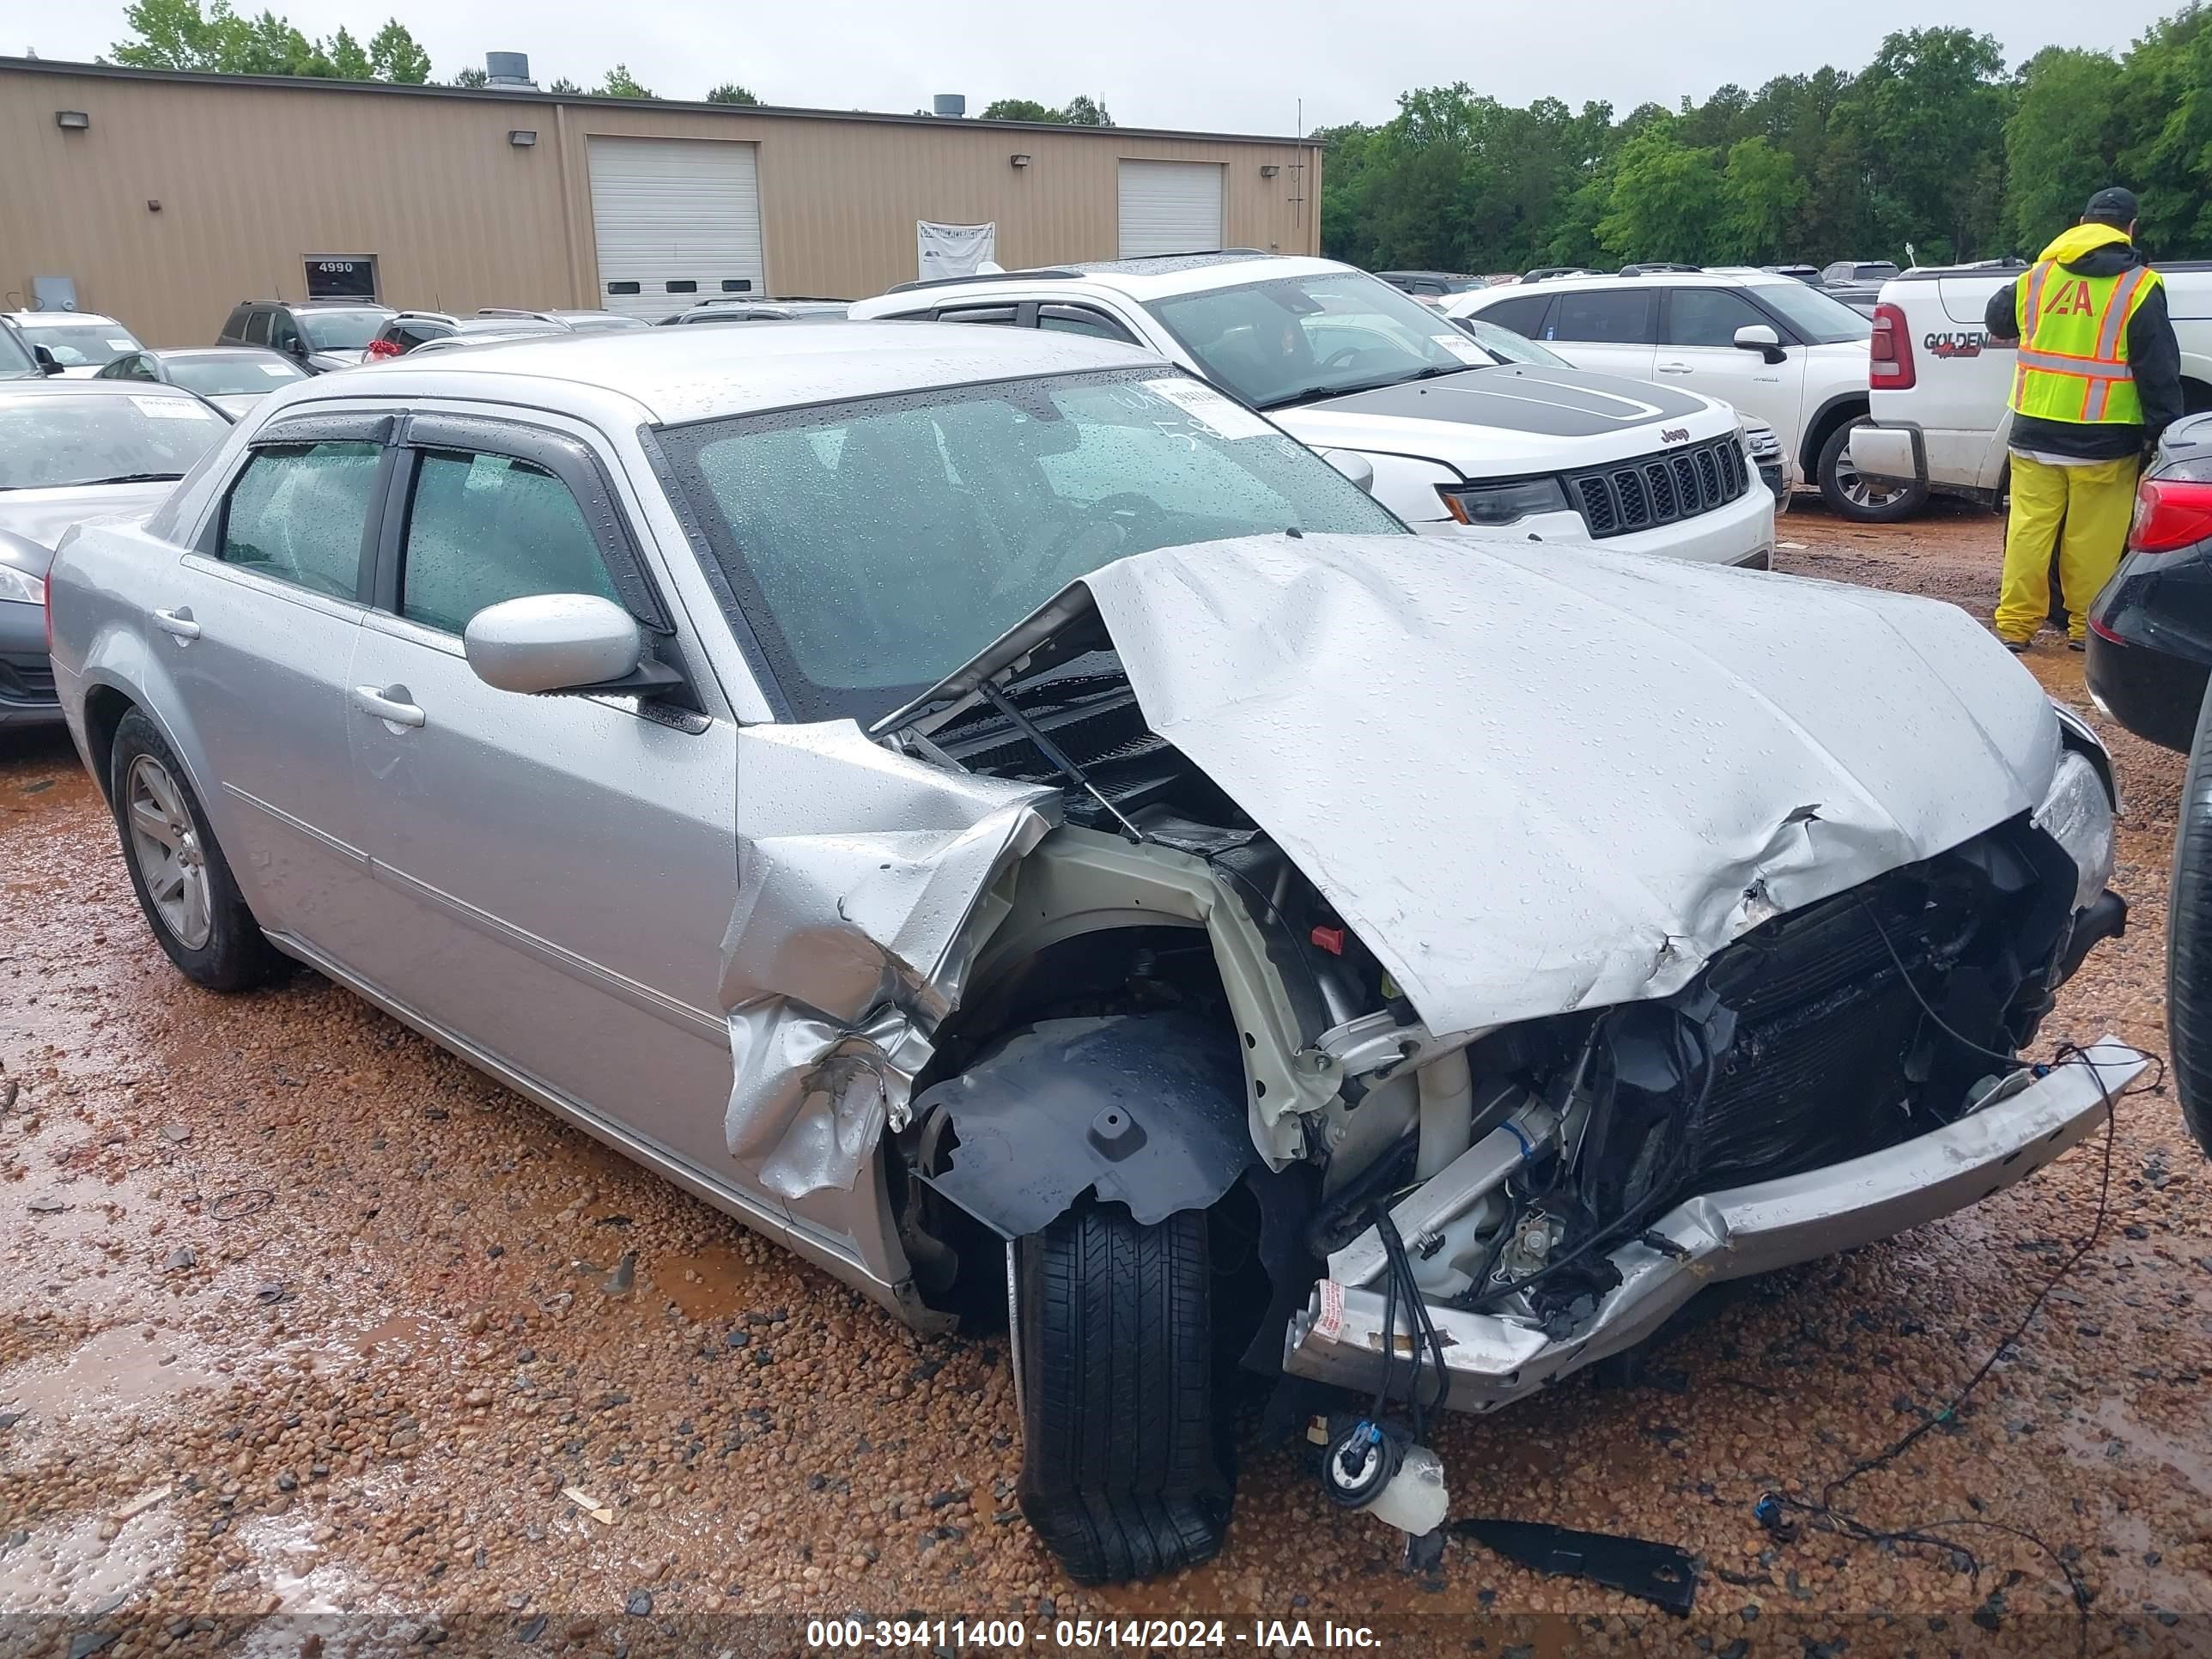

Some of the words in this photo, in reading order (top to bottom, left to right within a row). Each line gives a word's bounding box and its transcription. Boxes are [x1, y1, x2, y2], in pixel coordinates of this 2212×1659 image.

[319, 262, 353, 272] 4990
[1923, 331, 1990, 349] GOLDEN
[1661, 428, 1690, 443] Jeep
